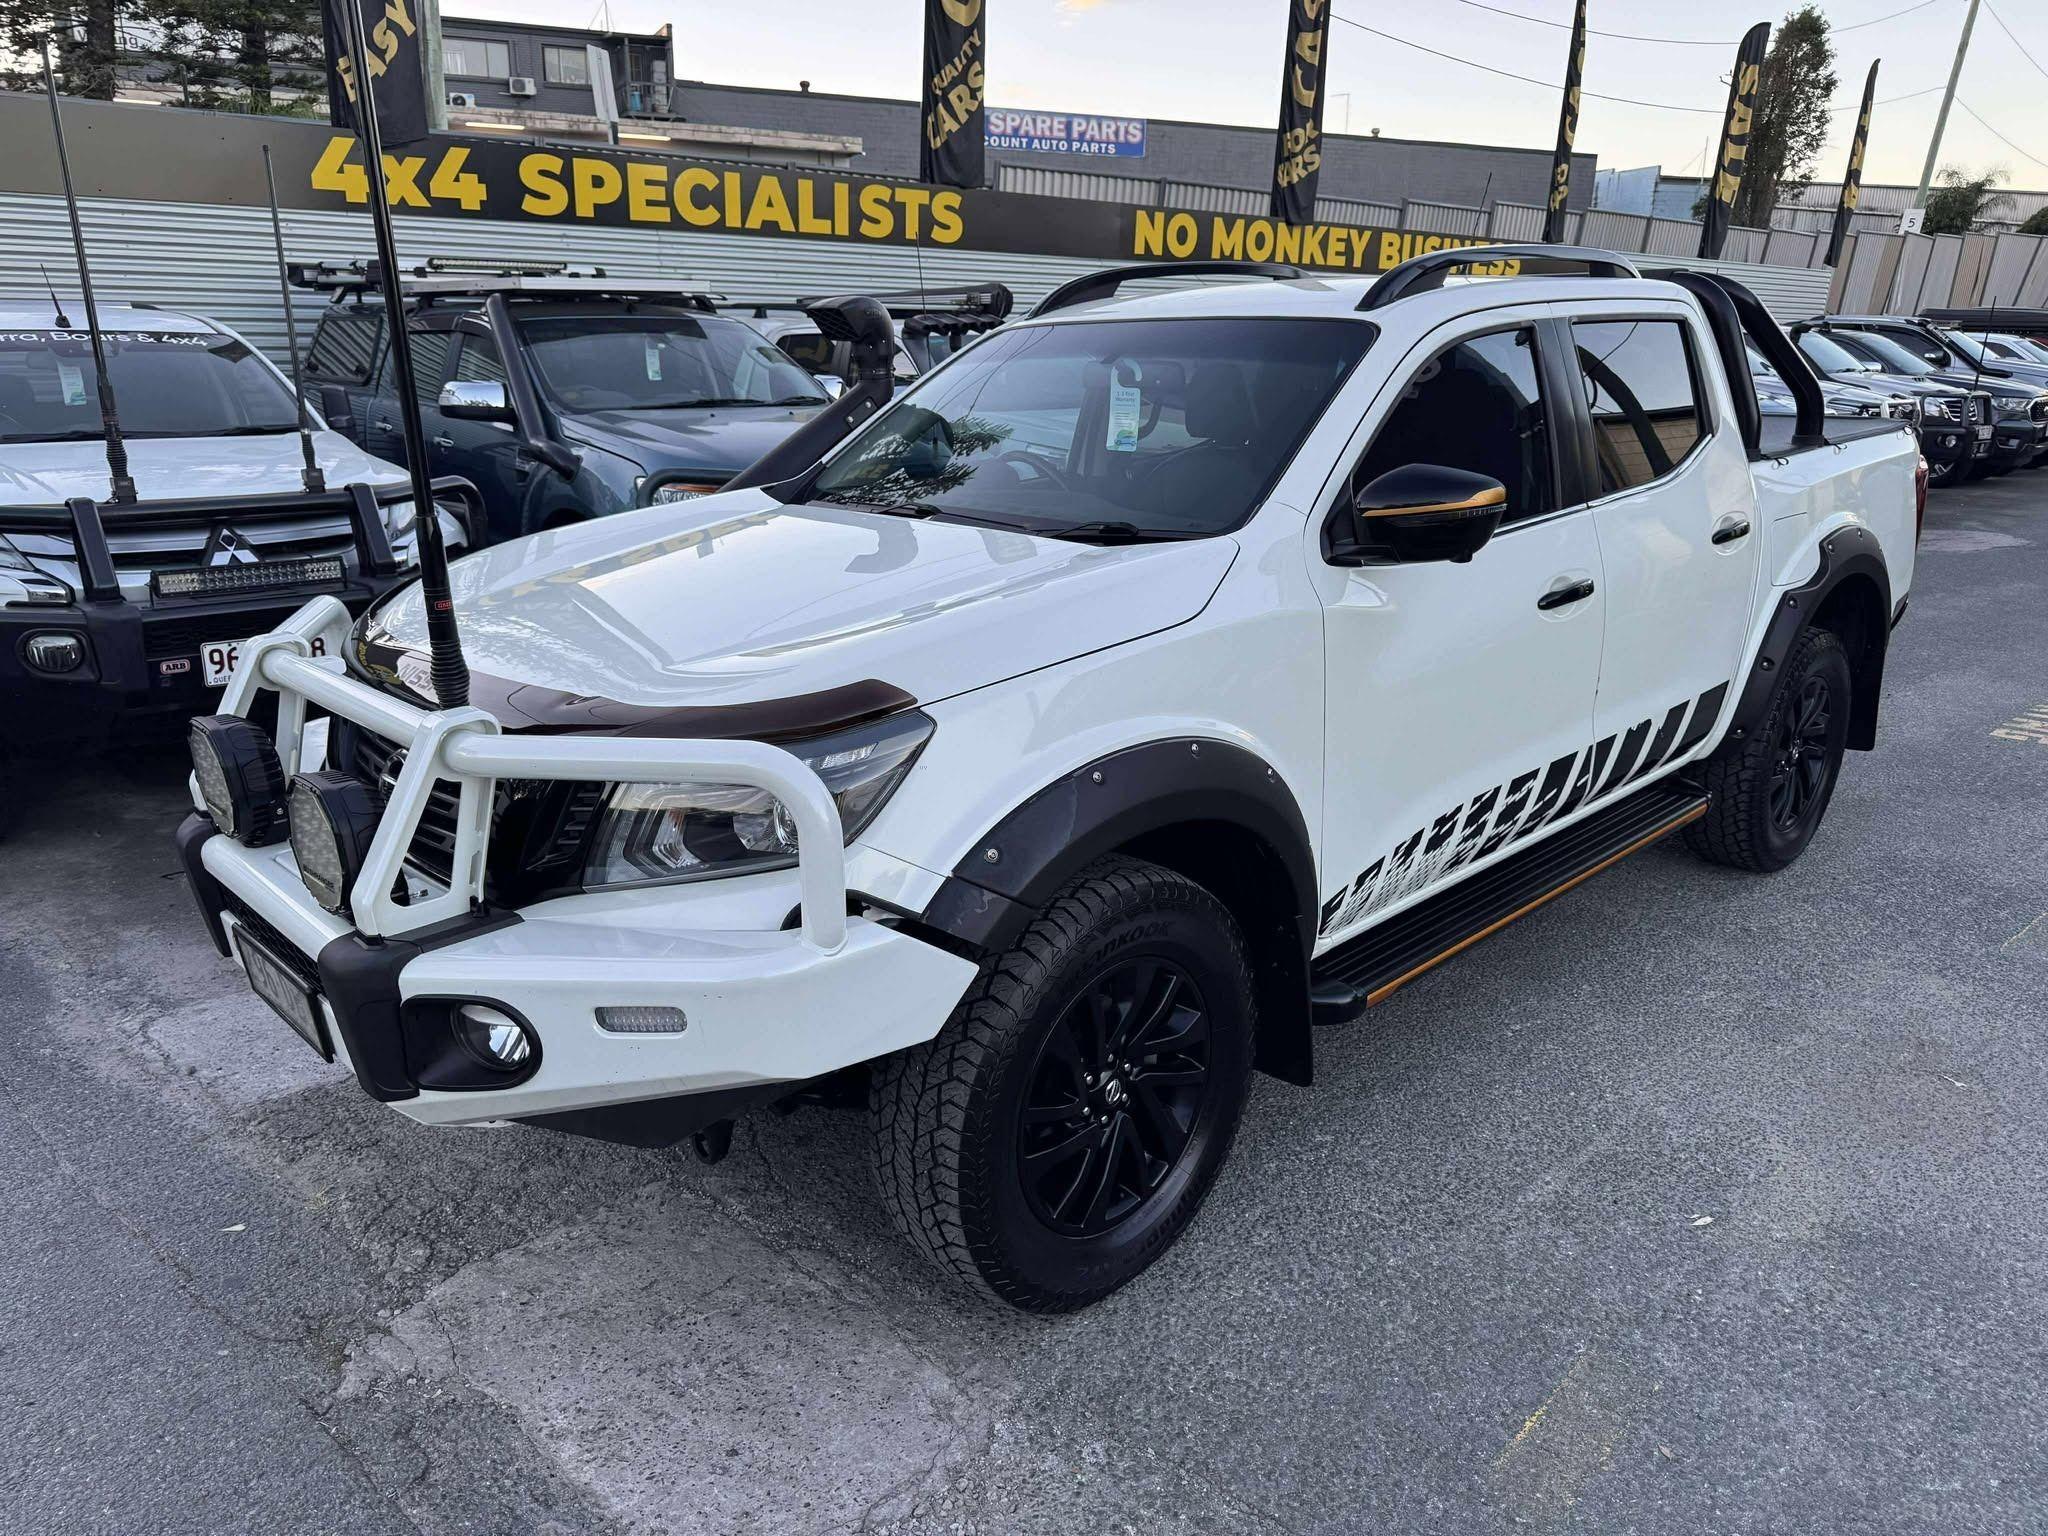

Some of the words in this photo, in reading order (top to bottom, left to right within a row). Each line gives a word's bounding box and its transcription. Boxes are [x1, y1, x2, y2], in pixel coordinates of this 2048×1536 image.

[931, 28, 981, 96] QUALITY
[927, 61, 984, 150] CARS
[988, 110, 1067, 138] SPARE
[1071, 116, 1143, 144] PARTS
[984, 136, 1028, 148] COUNT
[1032, 140, 1068, 151] AUTO
[1072, 141, 1116, 154] PARTS
[311, 136, 487, 211] 4x4
[518, 153, 963, 244] SPECIALISTS
[1134, 209, 1198, 259] NO
[1211, 216, 1373, 269] MONKEY
[1907, 217, 1916, 228] 5
[0, 333, 46, 342] rra,
[161, 335, 208, 346] 4x4
[164, 662, 187, 671] ARB
